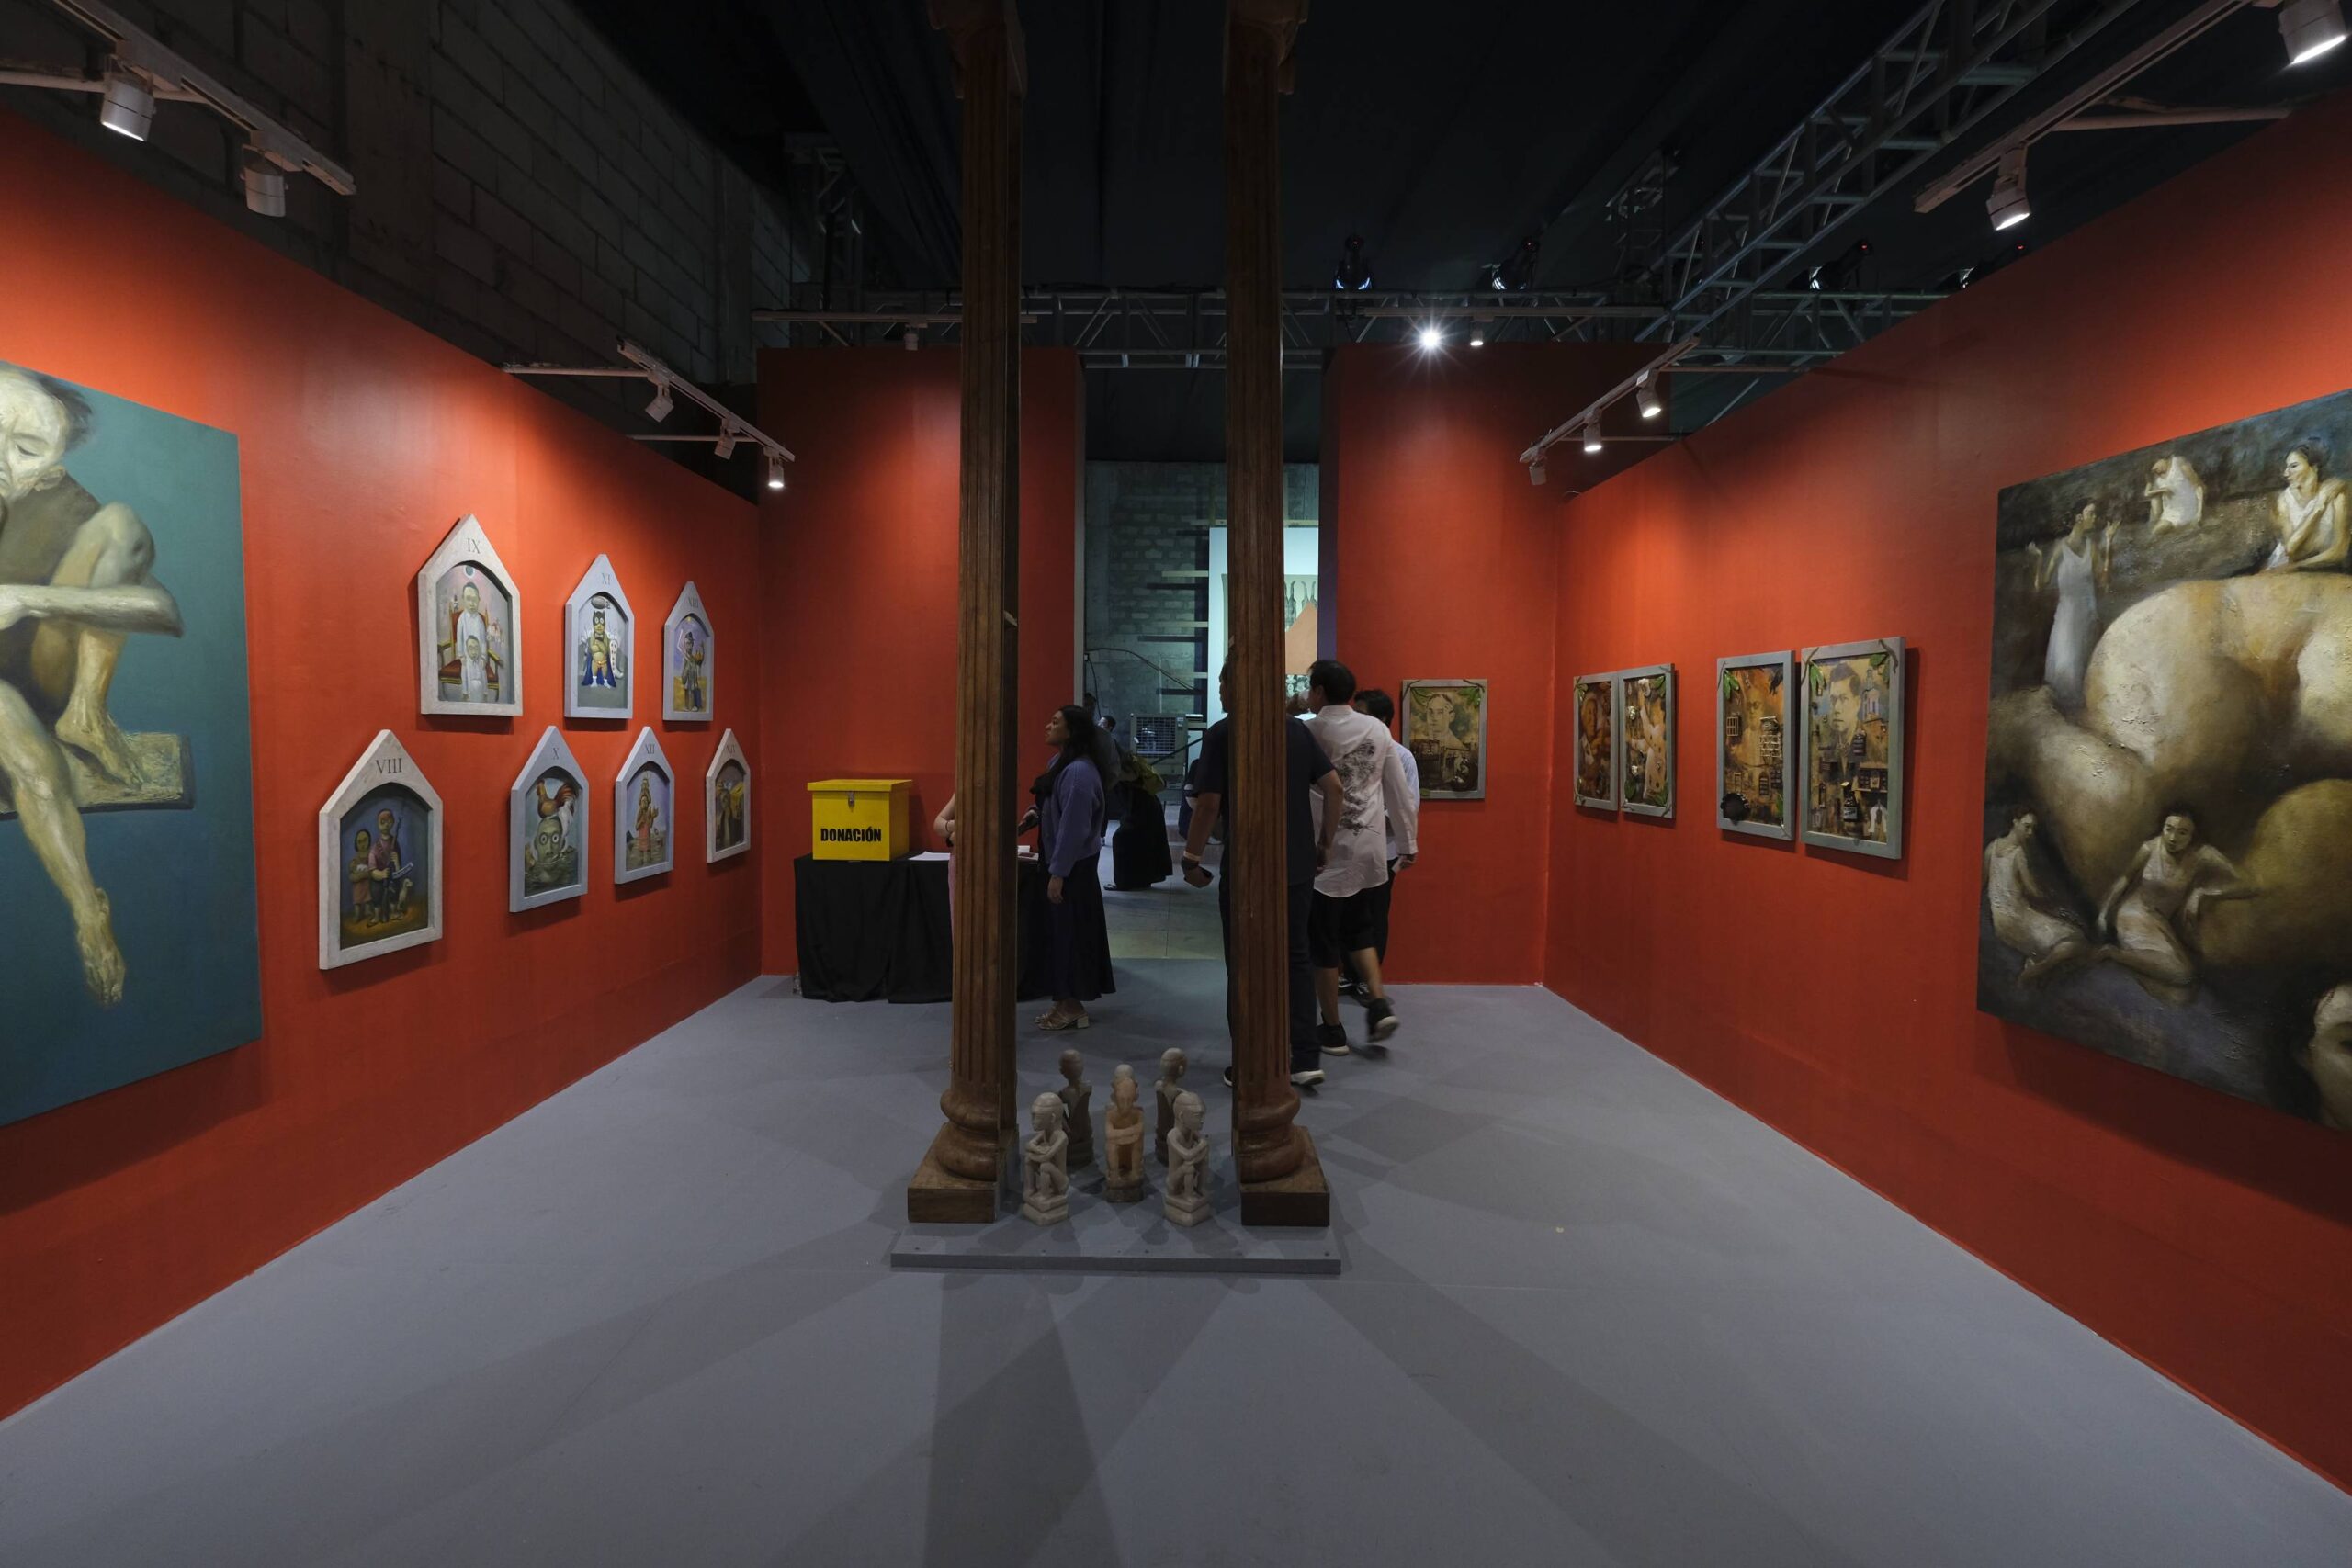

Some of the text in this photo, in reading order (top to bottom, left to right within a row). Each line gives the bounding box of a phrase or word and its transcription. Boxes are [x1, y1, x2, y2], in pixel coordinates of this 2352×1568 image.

[467, 537, 481, 554] IX
[601, 573, 610, 585] XI
[551, 747, 560, 760] X
[645, 743, 655, 754] XII
[375, 758, 402, 774] VIII
[820, 826, 882, 842] DONACIÓN
